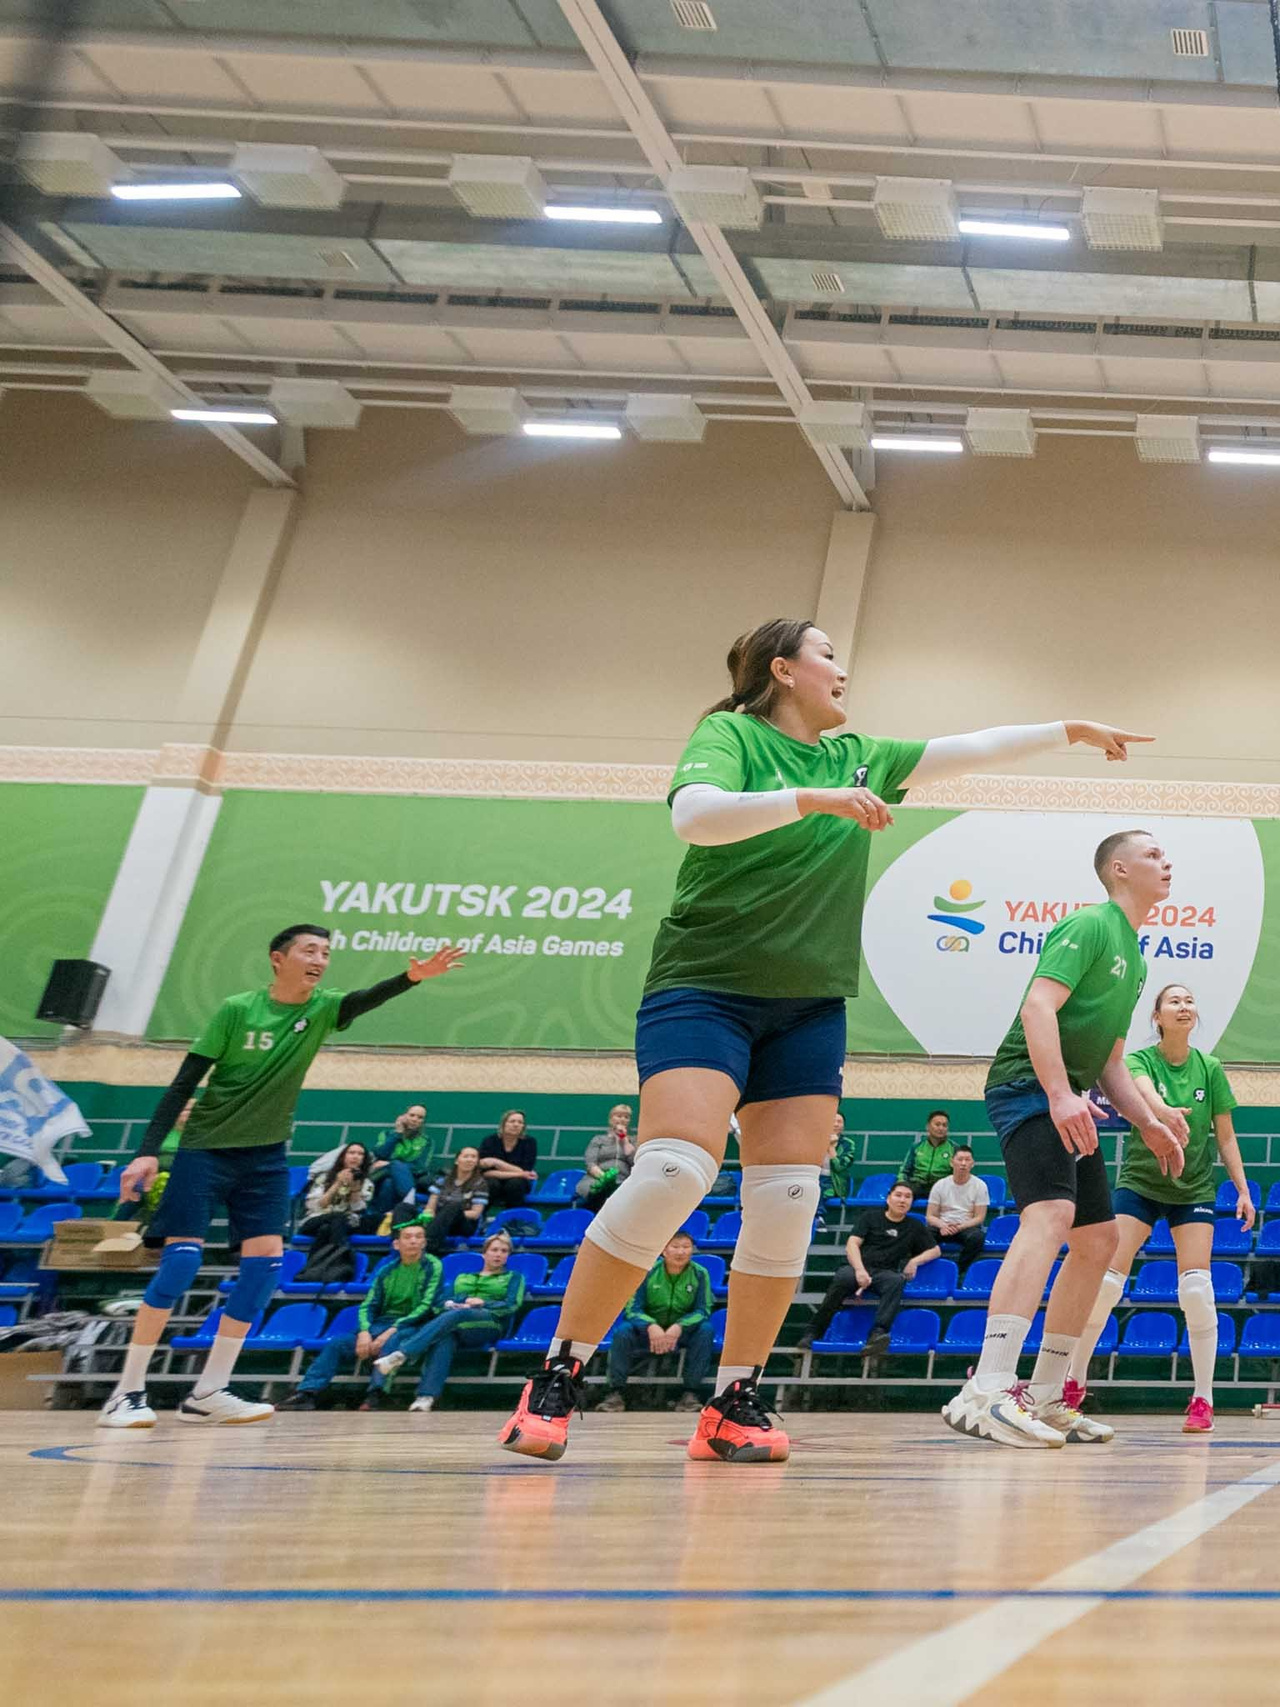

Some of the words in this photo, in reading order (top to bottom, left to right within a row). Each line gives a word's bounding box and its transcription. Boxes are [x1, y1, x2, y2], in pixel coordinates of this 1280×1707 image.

[320, 880, 518, 917] YAKUTSK
[522, 886, 633, 919] 2024
[1143, 904, 1216, 927] 2024
[352, 930, 452, 952] Children
[456, 933, 484, 953] of
[485, 934, 536, 955] Asia
[542, 936, 624, 957] Games
[1154, 936, 1214, 959] Asia
[243, 1031, 274, 1051] 15
